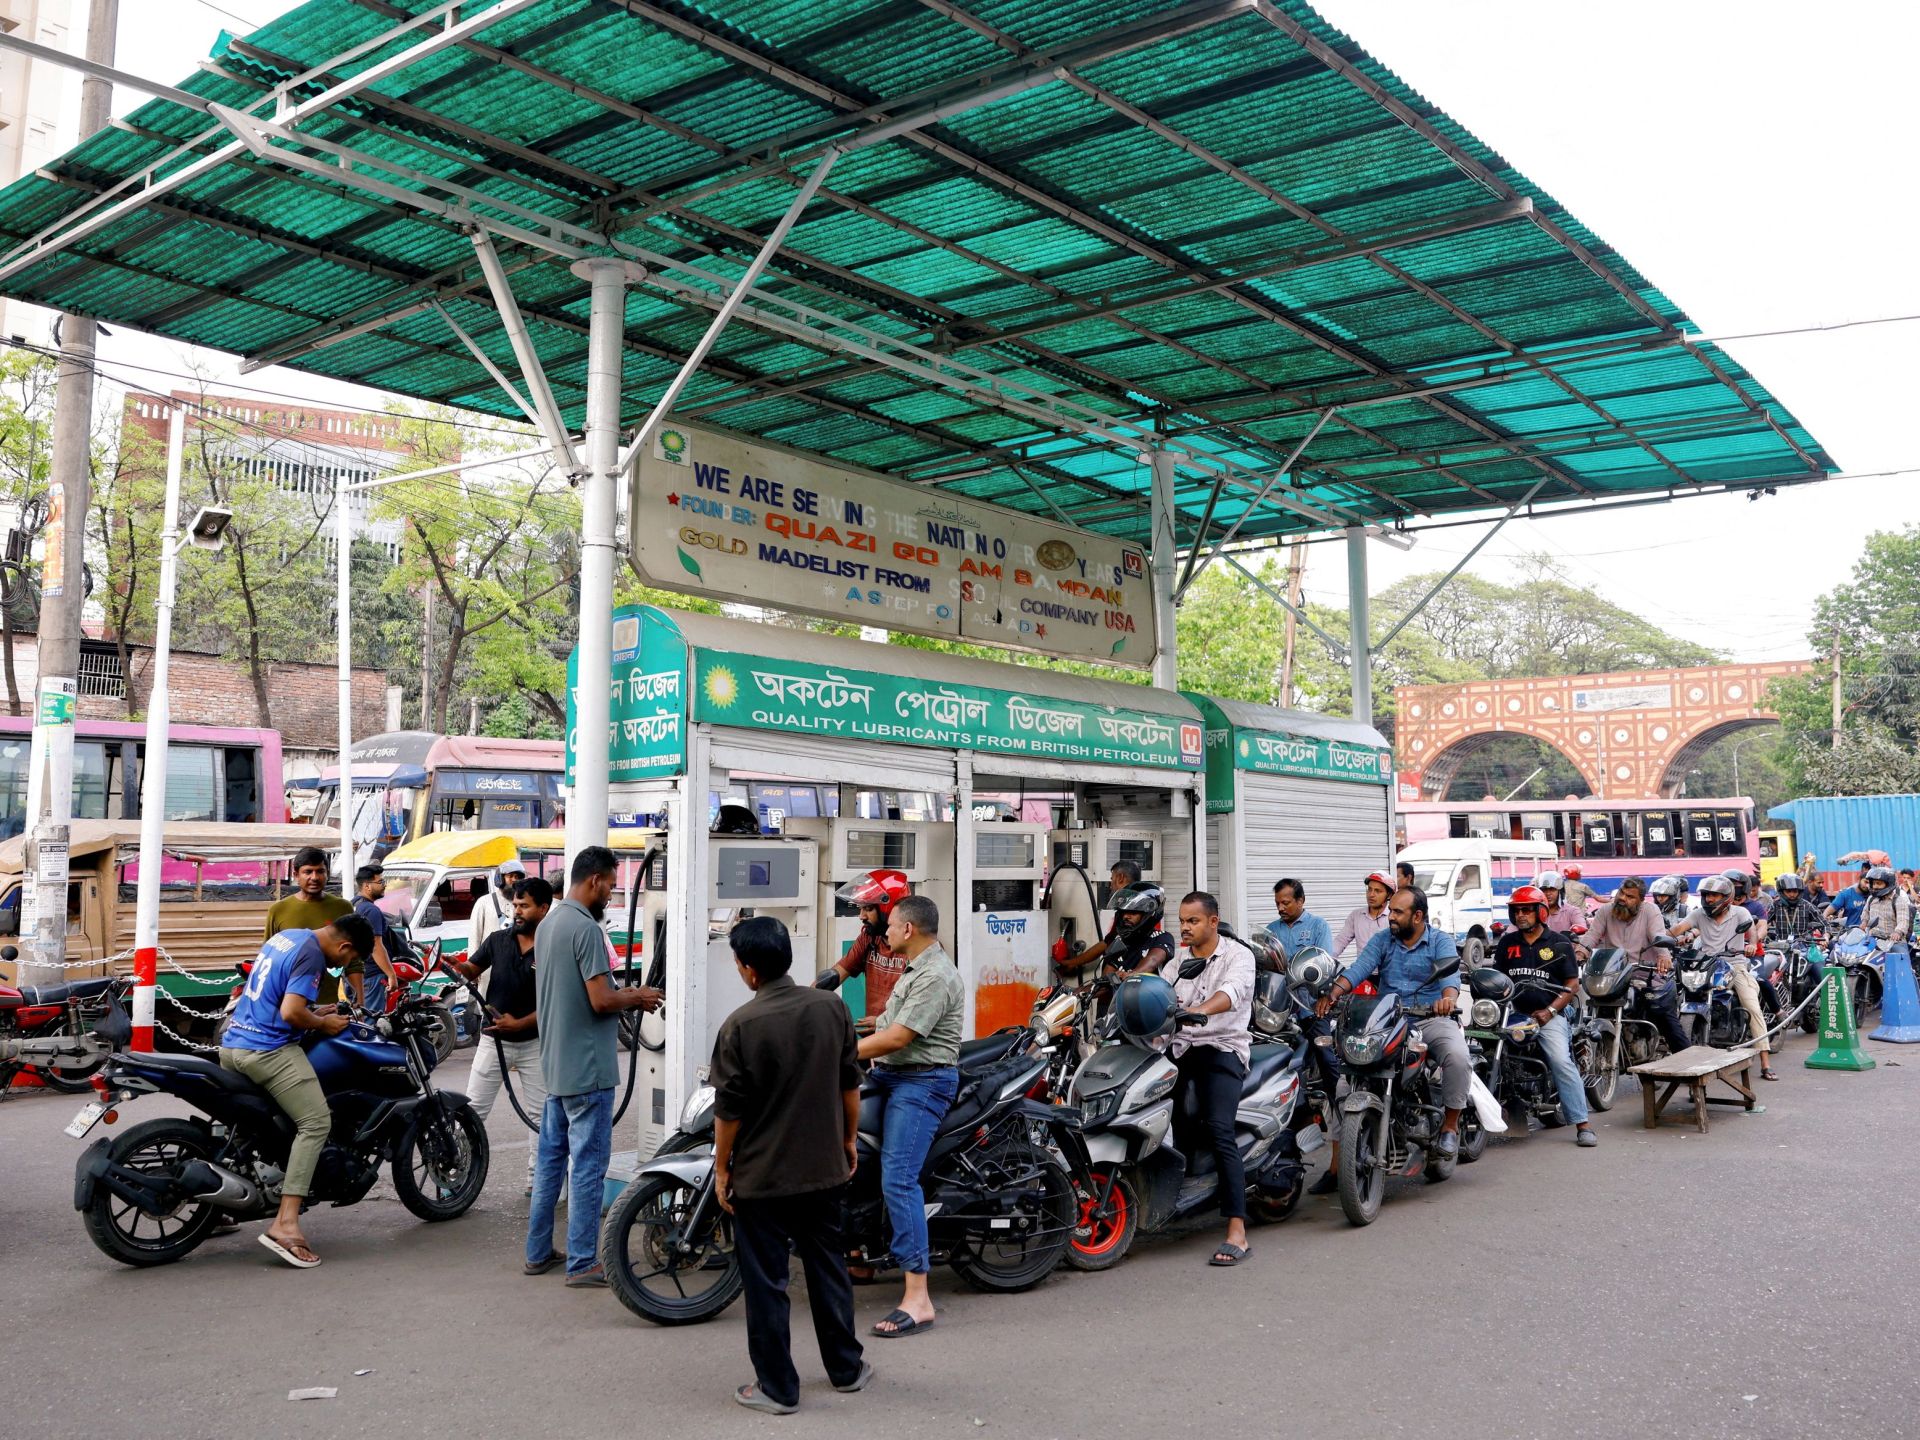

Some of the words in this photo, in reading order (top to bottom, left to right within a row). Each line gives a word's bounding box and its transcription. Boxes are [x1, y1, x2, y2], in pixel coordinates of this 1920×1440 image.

[694, 461, 730, 494] WE
[740, 475, 784, 508] ARE
[765, 512, 877, 553] QUAZI
[679, 526, 749, 556] GOLD
[758, 542, 870, 581] MADELIST
[874, 567, 931, 594] FROM
[1020, 597, 1099, 627] COMPANY
[1104, 609, 1137, 633] USA
[846, 585, 864, 602] A
[867, 590, 919, 612] STEP
[628, 667, 681, 704] ডিজেল
[622, 706, 681, 747] অকটেন
[750, 670, 876, 716] অকটেন
[895, 686, 992, 729] পেট্রোল
[1005, 696, 1085, 740] ডিজেল
[1097, 715, 1176, 750] অকটেন
[751, 710, 846, 731] QUALITY
[851, 720, 972, 744] LUBRICANTS
[977, 735, 1026, 750] FROM
[1031, 740, 1089, 757] BRITISH
[1093, 747, 1178, 765] PETROLEUM
[1255, 737, 1319, 767] অকটেন
[1327, 741, 1378, 773] ডিজেল
[616, 757, 630, 770] FROM
[631, 755, 650, 770] BRITISH
[650, 753, 681, 767] PETROLEUM
[1254, 761, 1279, 771] QUALITY
[1280, 763, 1314, 775] LUBRICANTS
[1314, 768, 1329, 776] FROM
[985, 913, 1027, 935] ডিজেল
[1507, 945, 1521, 959] 71
